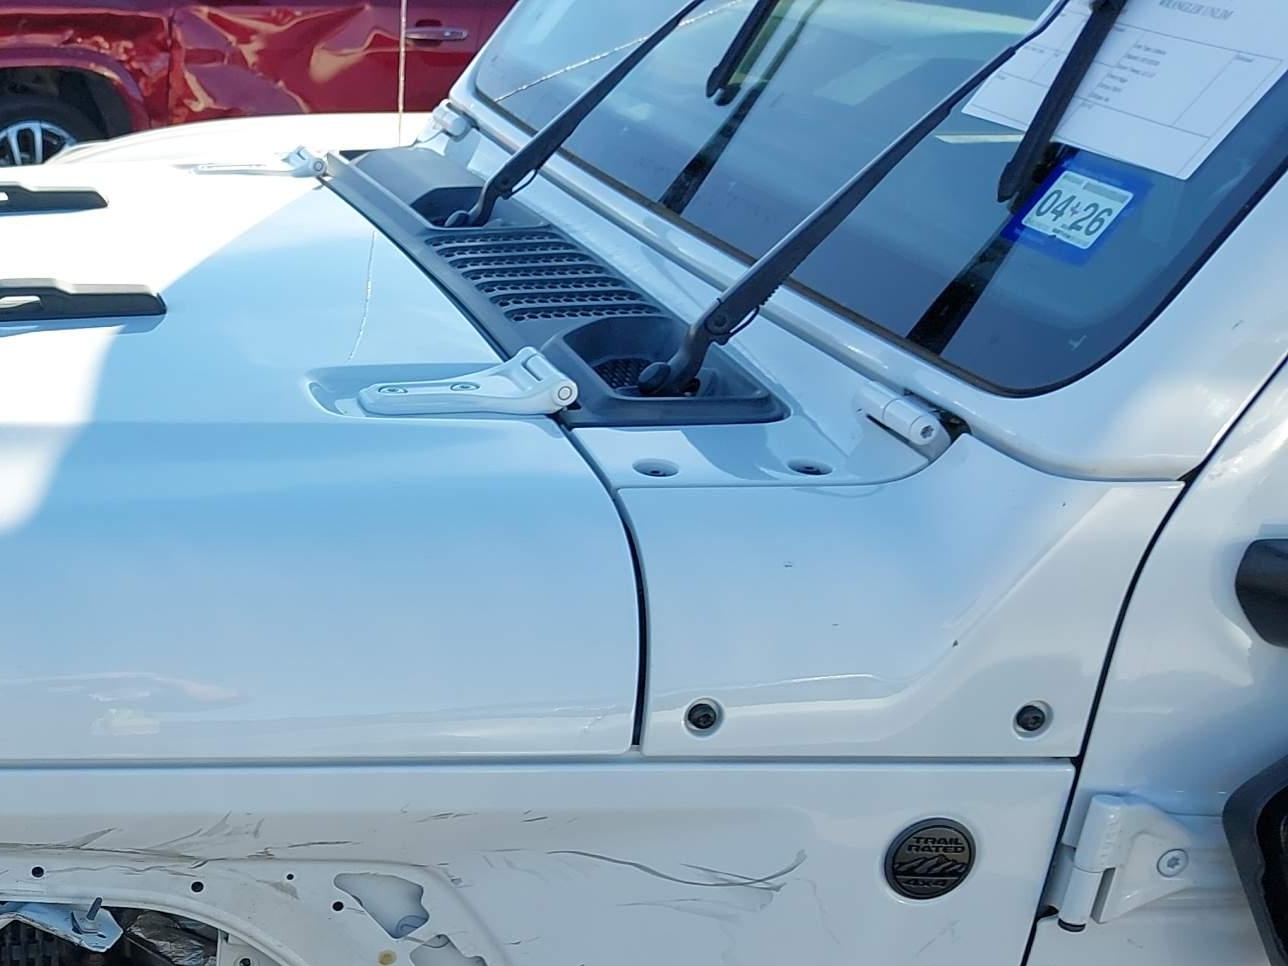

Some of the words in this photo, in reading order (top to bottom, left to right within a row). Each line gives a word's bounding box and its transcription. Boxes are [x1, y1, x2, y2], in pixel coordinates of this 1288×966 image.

[1035, 190, 1077, 222] 04
[1069, 202, 1113, 236] 26
[912, 836, 964, 846] TRAIL
[906, 844, 966, 854] RATED
